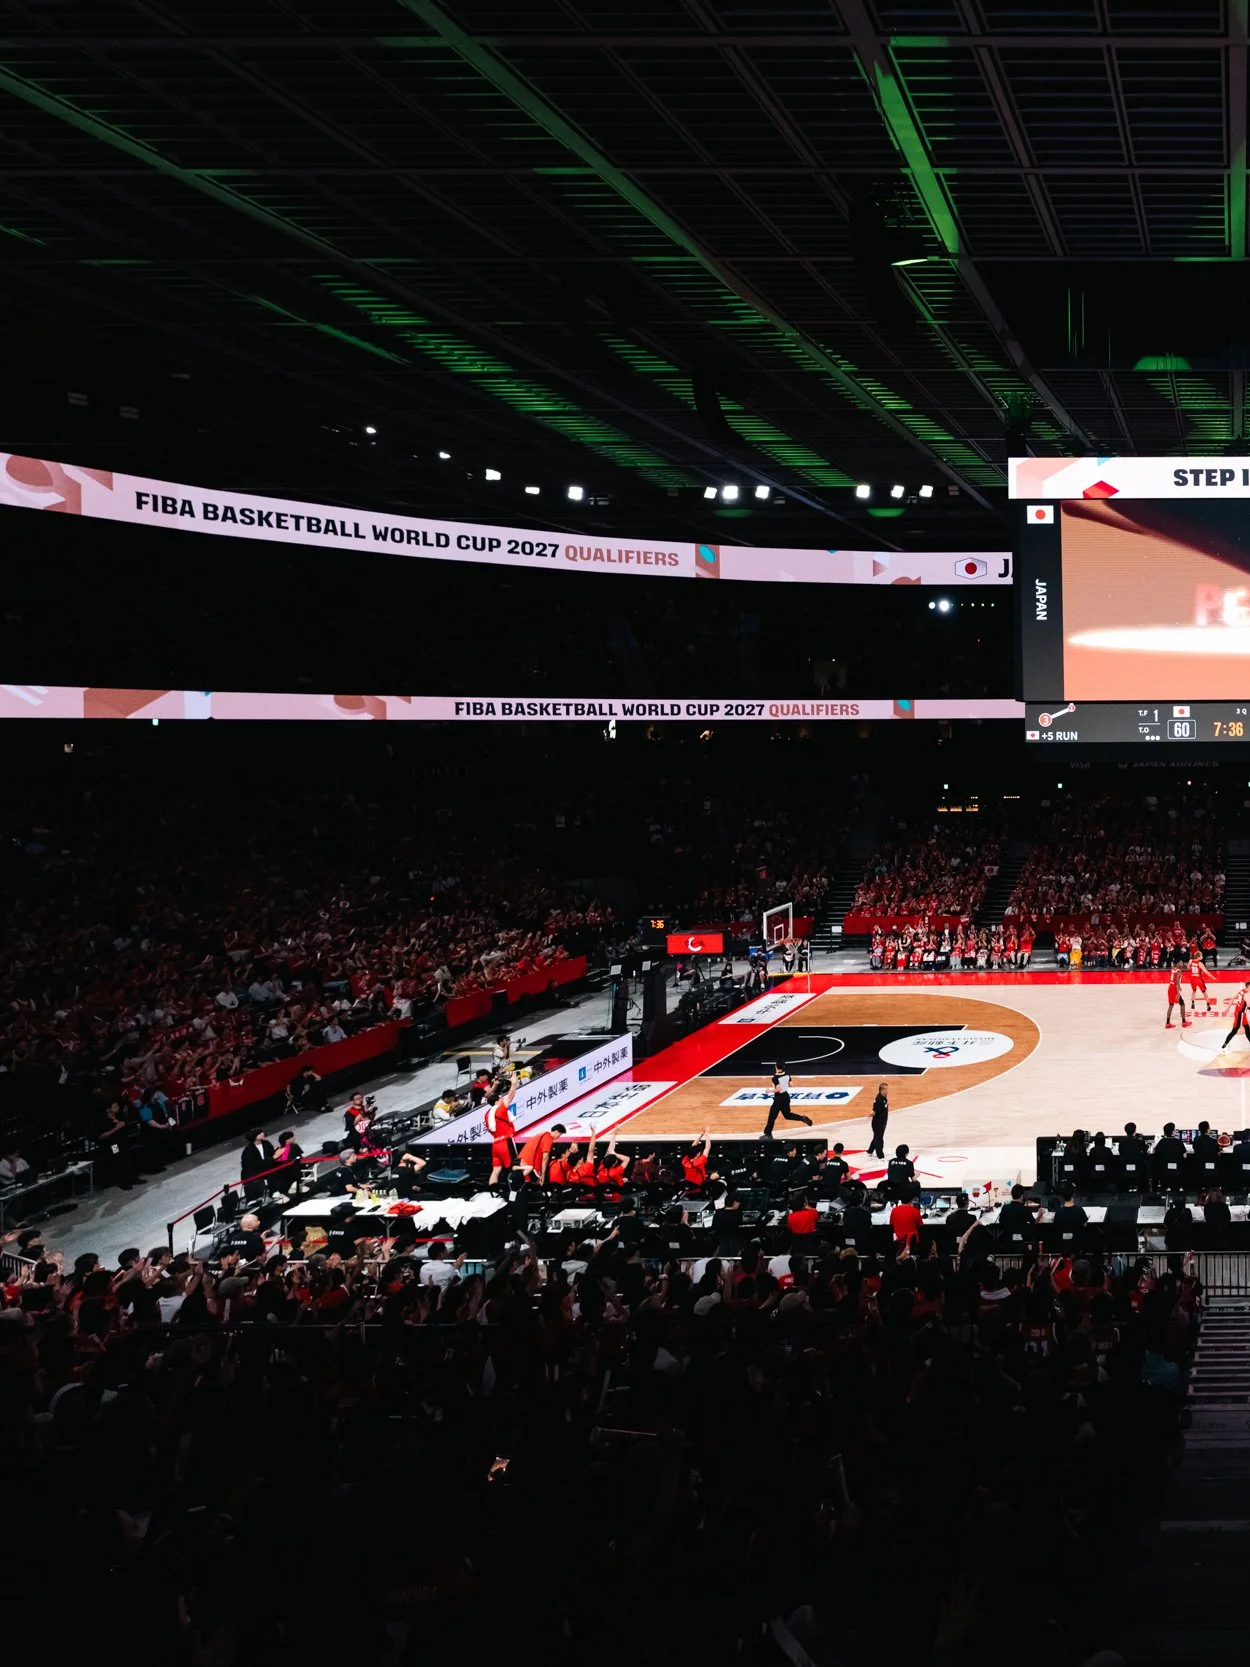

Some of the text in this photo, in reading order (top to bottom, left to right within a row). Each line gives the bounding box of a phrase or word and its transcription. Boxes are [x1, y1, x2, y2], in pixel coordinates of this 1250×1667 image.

[1174, 469, 1232, 486] STEP
[136, 492, 679, 566] FIBA BASKETBALL WORLD CUP 2027 QUALIFIERS
[1036, 579, 1047, 620] JAPAN
[455, 702, 859, 717] FIBA BASKETBALL WORLD CUP 2027 QUALIFIERS
[1154, 709, 1159, 722] 1
[1042, 716, 1049, 725] 3
[1042, 732, 1077, 740] +5 RUN
[1174, 722, 1190, 737] 60
[1214, 722, 1243, 736] 7:36
[651, 920, 664, 928] 7:36
[593, 1046, 629, 1074] 中外製薬
[526, 1077, 569, 1110] 中外製薬
[447, 1122, 491, 1143] 外製
